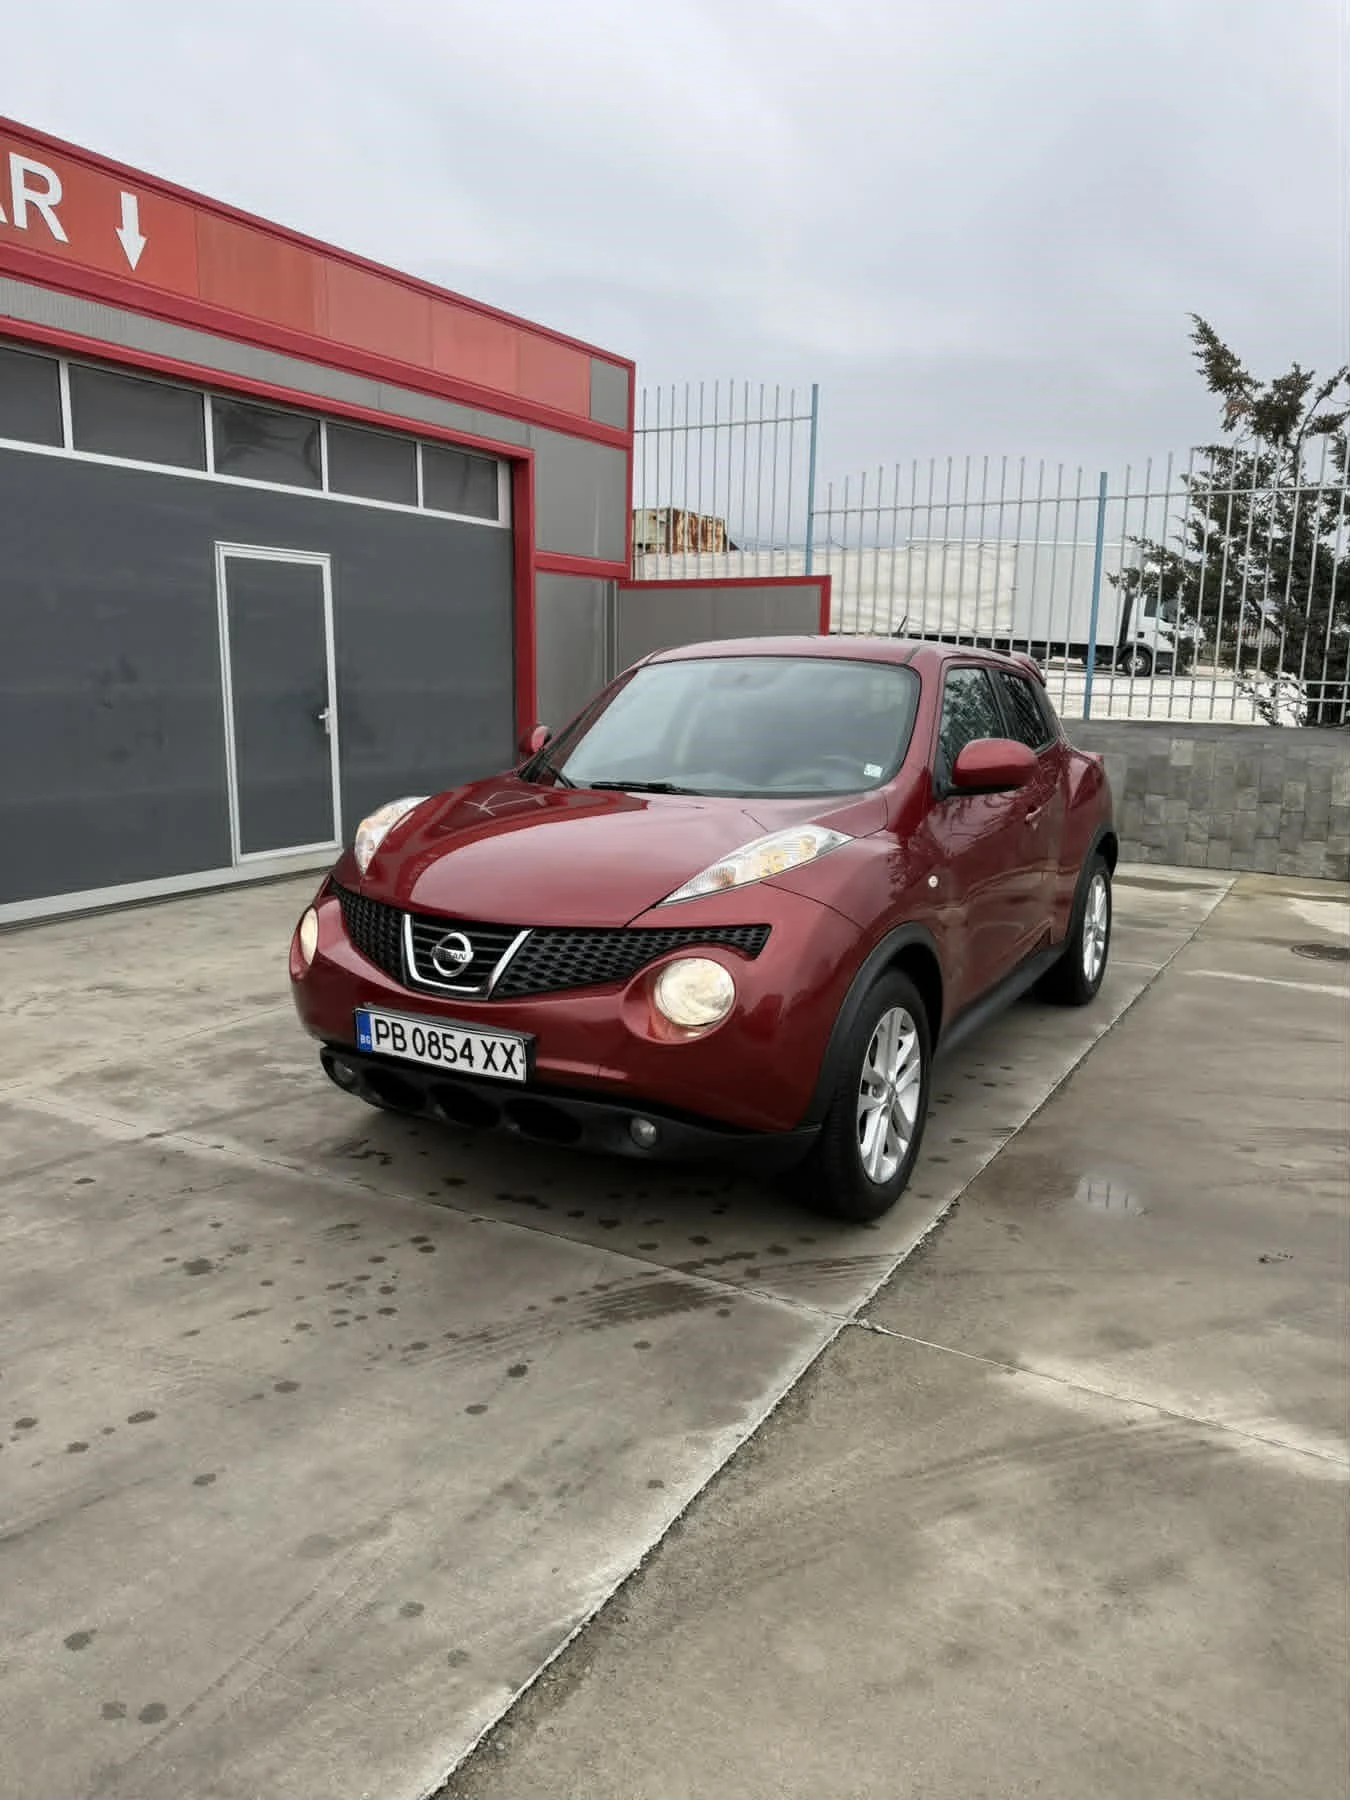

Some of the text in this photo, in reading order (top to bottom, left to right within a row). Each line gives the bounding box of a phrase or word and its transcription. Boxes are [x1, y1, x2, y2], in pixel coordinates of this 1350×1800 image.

[374, 1018, 518, 1075] PB 0854 XX
